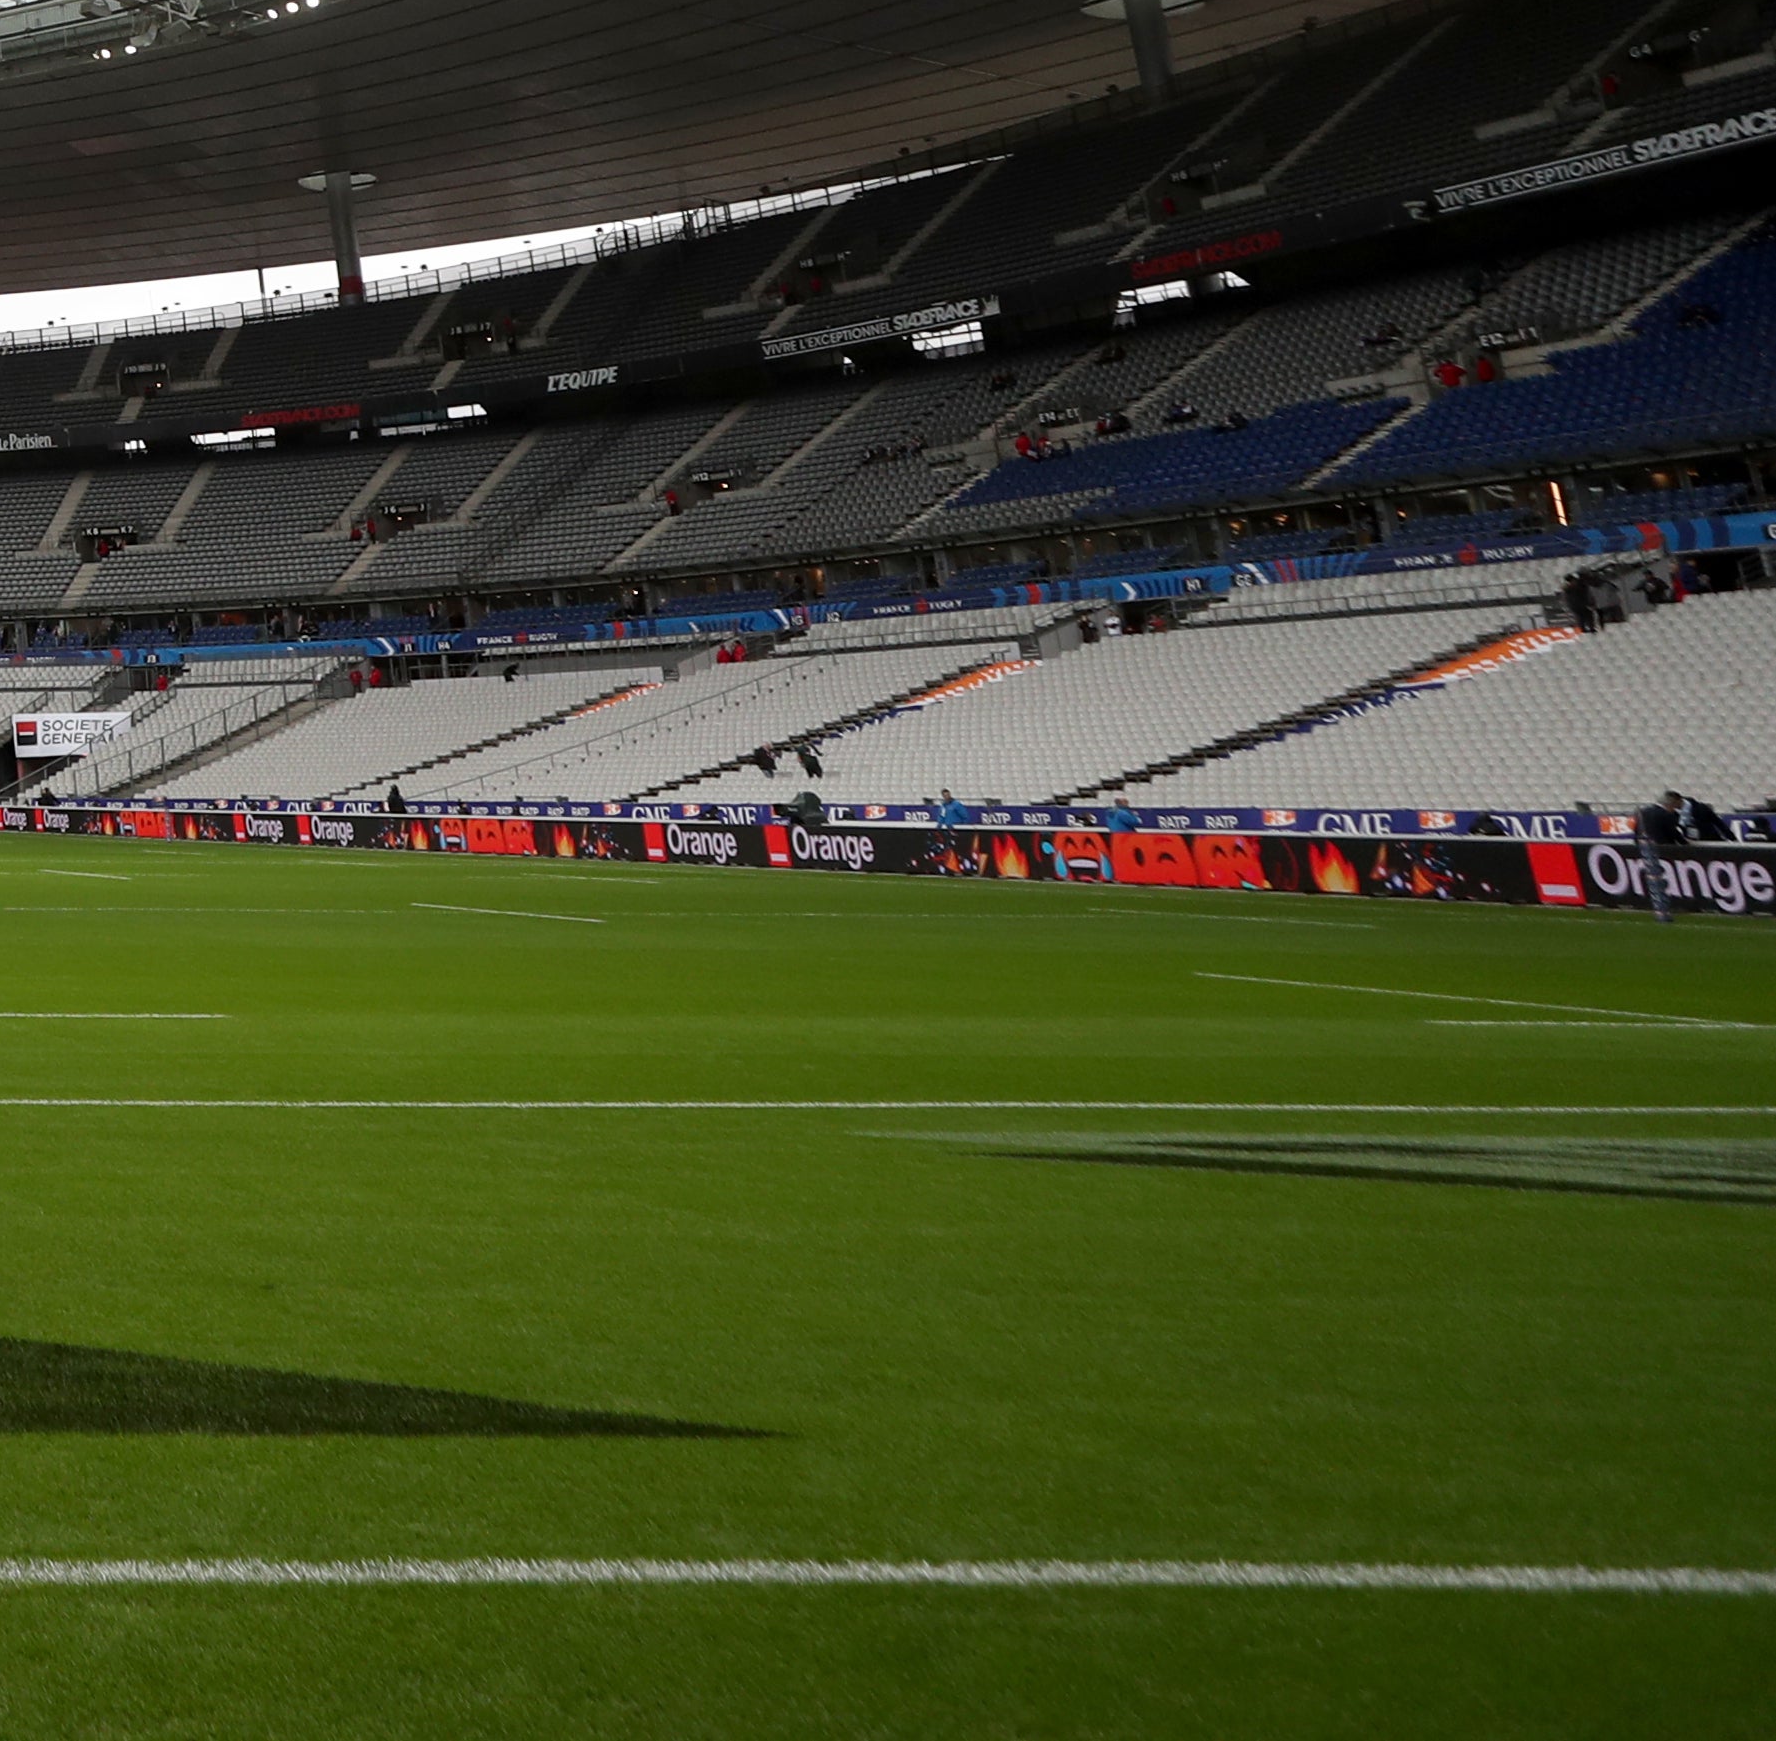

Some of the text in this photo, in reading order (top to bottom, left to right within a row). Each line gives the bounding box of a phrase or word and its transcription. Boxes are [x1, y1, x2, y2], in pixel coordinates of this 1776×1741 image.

[1433, 183, 1485, 209] VIVRE
[1487, 151, 1633, 197] L'EXCEPTIONNEL
[762, 339, 799, 357] VIVRE
[799, 321, 893, 351] L'EXCEPTIONNEL
[547, 365, 620, 393] L'EQUIPE
[476, 635, 513, 645] FRANCE
[41, 719, 112, 731] SOCIETE
[41, 732, 109, 746] GENERA
[343, 802, 373, 814] GMF
[424, 806, 442, 814] RATP
[471, 807, 489, 815] RATP
[496, 807, 514, 815] RATP
[519, 807, 539, 816] RATP
[547, 807, 565, 816] RATP
[571, 807, 591, 816] RATP
[632, 807, 671, 820] GMF
[2, 809, 28, 831] Orange
[43, 809, 70, 833] Orange
[904, 810, 931, 822] RATP
[981, 810, 1011, 825] RATP
[1023, 812, 1051, 825] RATP
[1157, 814, 1190, 829] RATP
[1204, 814, 1239, 829] RATP
[244, 812, 284, 838] Orange
[310, 814, 354, 847] Orange
[1316, 813, 1393, 835] GMF
[667, 823, 738, 864] Orange
[792, 825, 875, 870] Orange
